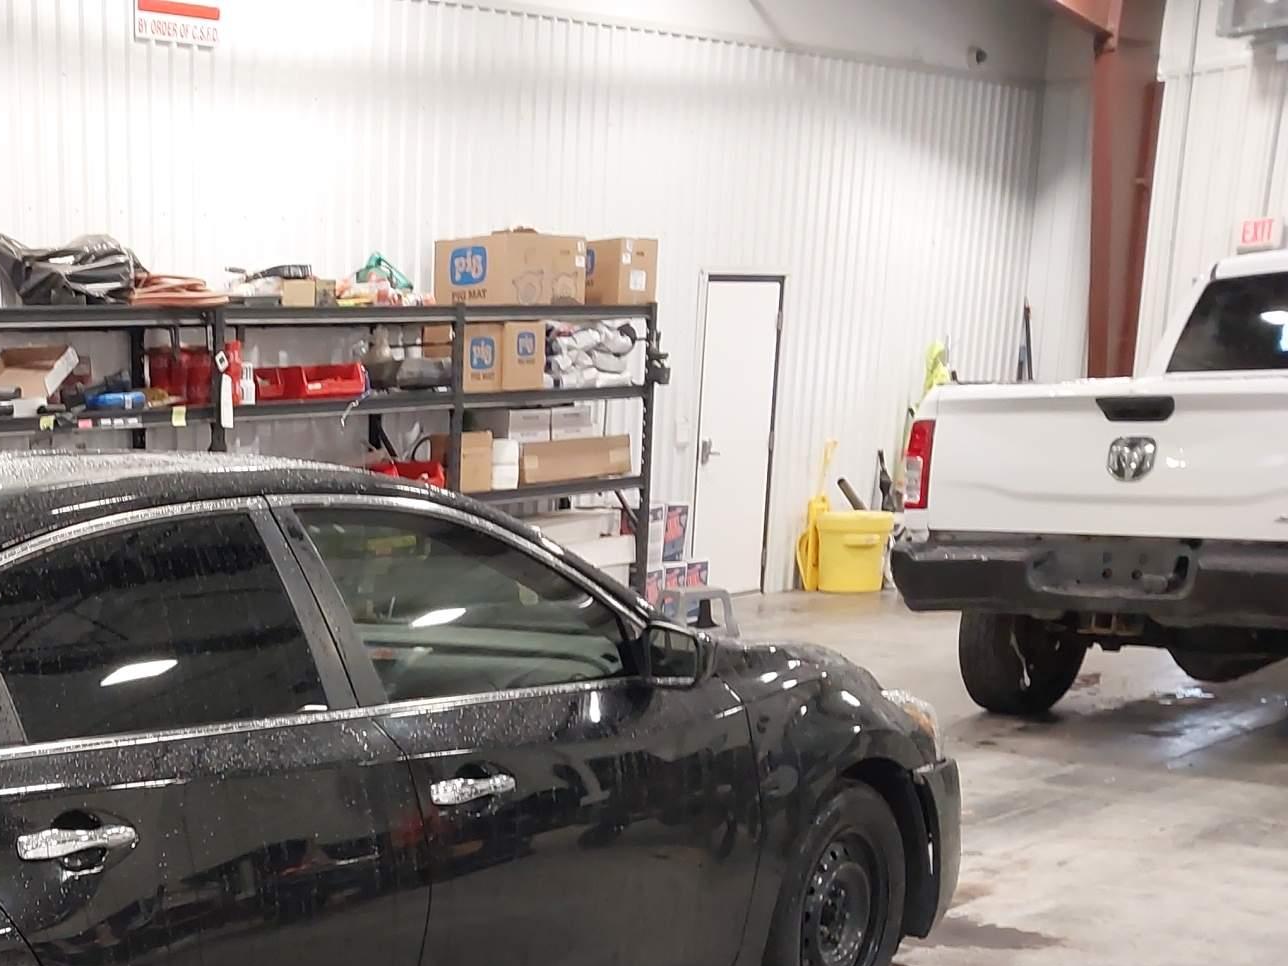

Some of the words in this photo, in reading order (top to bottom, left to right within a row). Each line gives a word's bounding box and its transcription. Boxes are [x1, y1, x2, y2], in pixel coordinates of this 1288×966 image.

[137, 17, 147, 32] BY
[150, 19, 178, 38] ORDER
[179, 23, 190, 39] OF
[1241, 218, 1273, 244] EXIT
[468, 287, 487, 300] MAT
